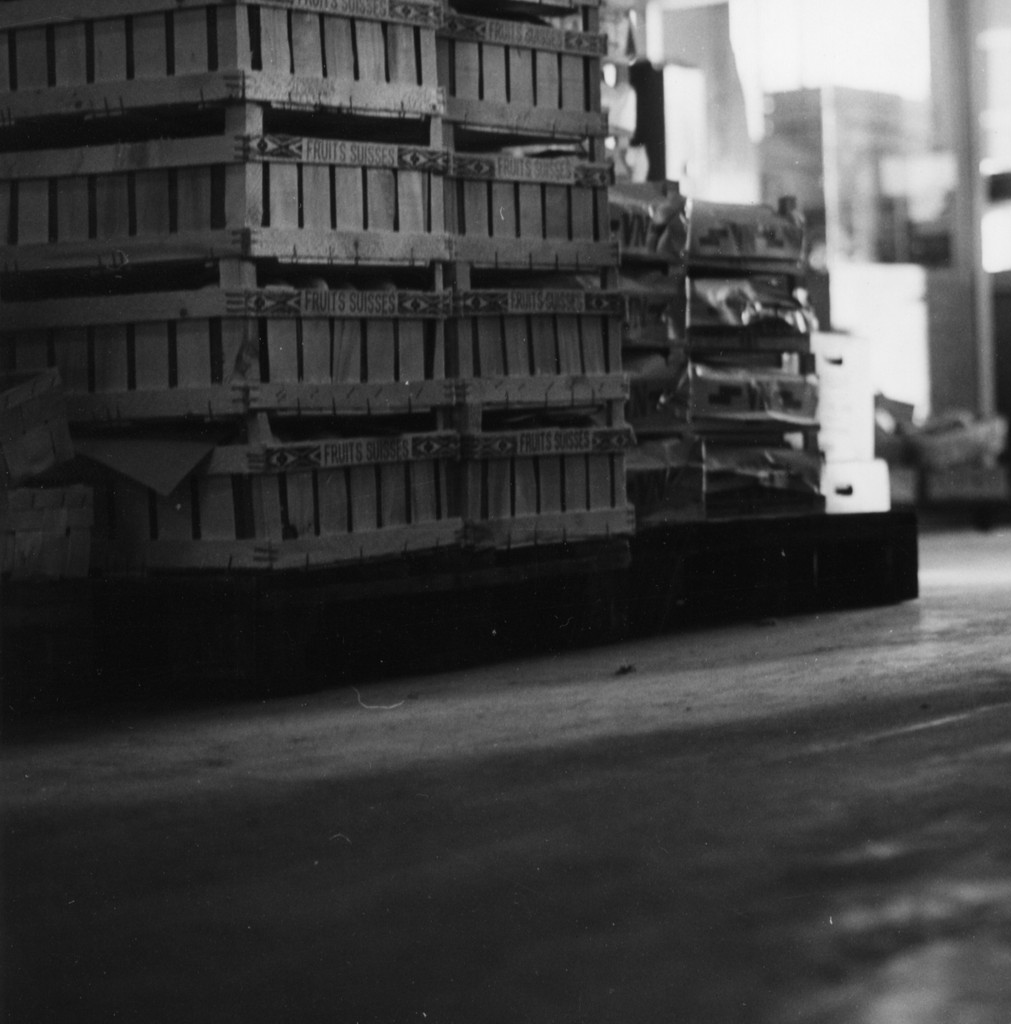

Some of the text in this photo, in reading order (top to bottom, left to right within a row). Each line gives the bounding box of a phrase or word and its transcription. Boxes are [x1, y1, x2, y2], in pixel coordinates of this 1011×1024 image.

[489, 22, 563, 47] FRUITS SUISSES
[308, 140, 396, 165] FRUITS SUISSES
[499, 157, 571, 180] FRUITS SUISSES
[305, 291, 396, 313] FRUITS SUISSES
[510, 291, 583, 311] FRUITS SUISSES
[323, 438, 410, 464] FRUITS SUISSES
[520, 430, 590, 453] FRUITS SUISSES
